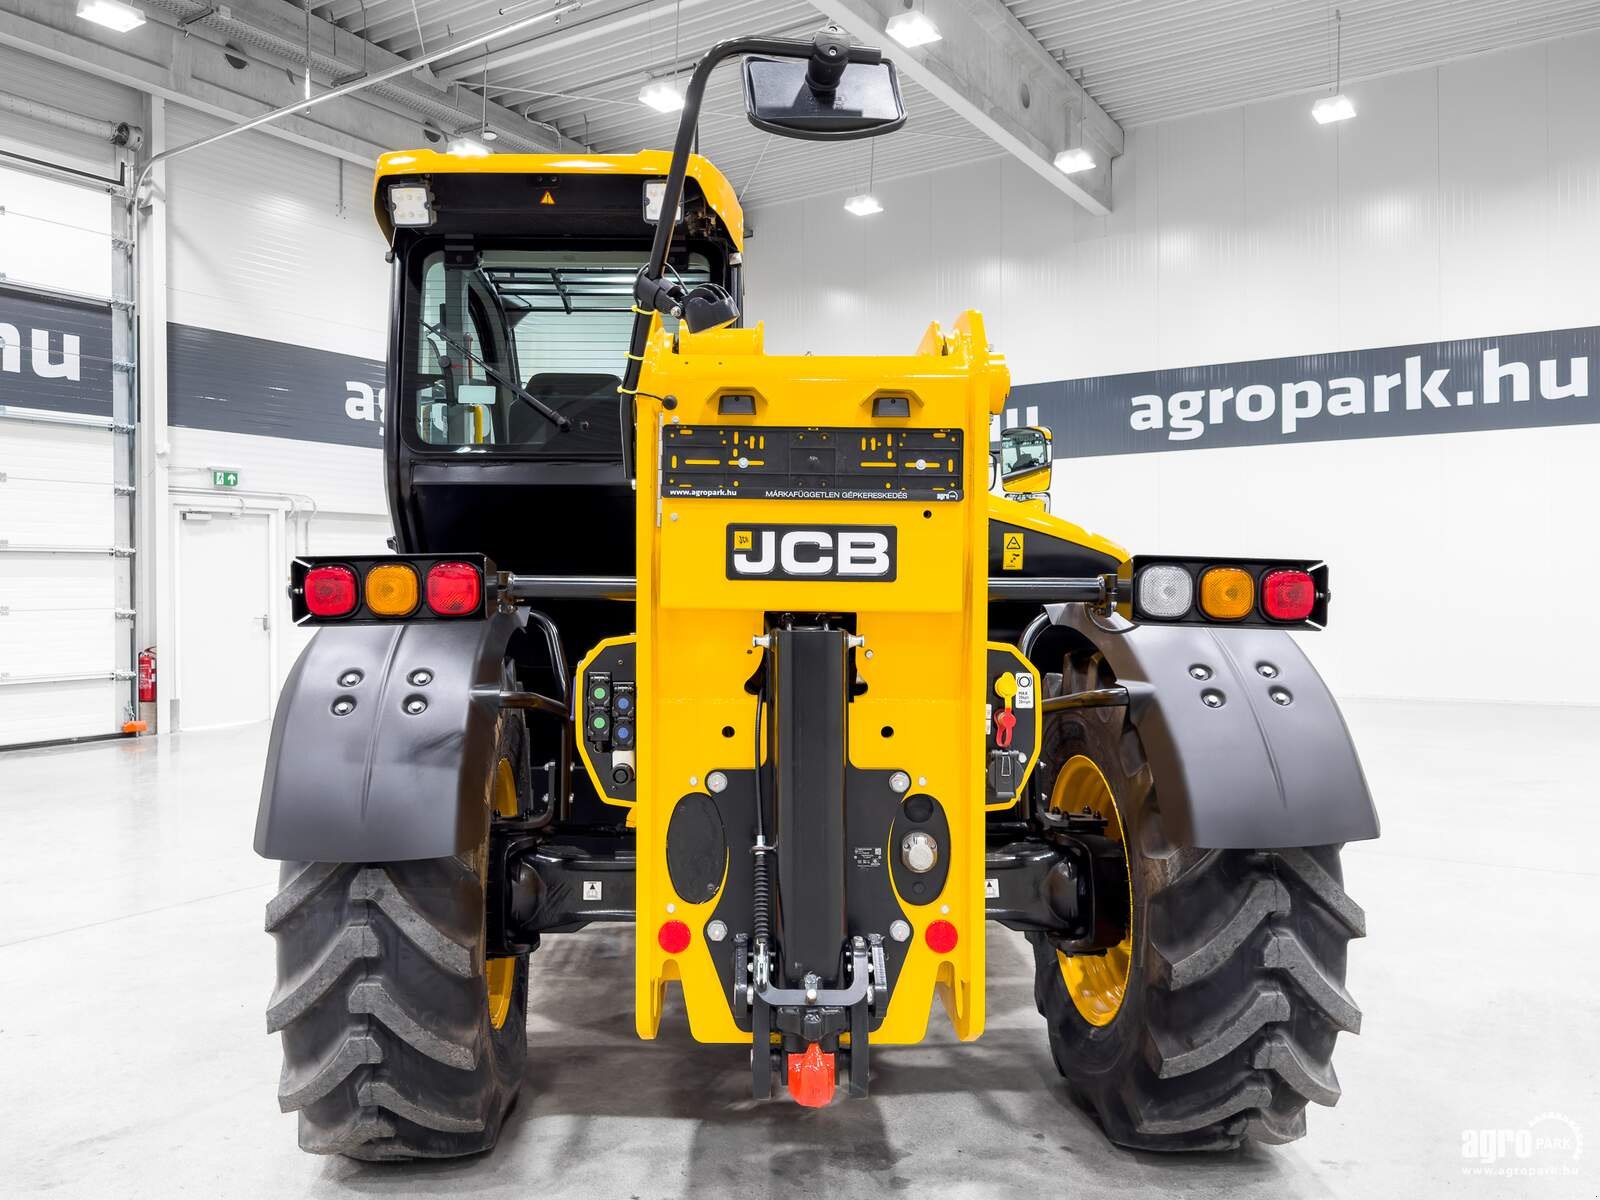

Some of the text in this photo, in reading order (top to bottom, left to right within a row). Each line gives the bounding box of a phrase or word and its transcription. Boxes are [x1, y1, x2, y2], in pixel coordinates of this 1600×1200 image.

[345, 381, 385, 437] a
[1129, 347, 1589, 441] agropark.hu
[669, 488, 737, 497] www.agropark.hu
[765, 489, 908, 499] MÁRKAFÜGGETLEN GÉPKERESKEDÉS
[733, 530, 890, 576] JCB
